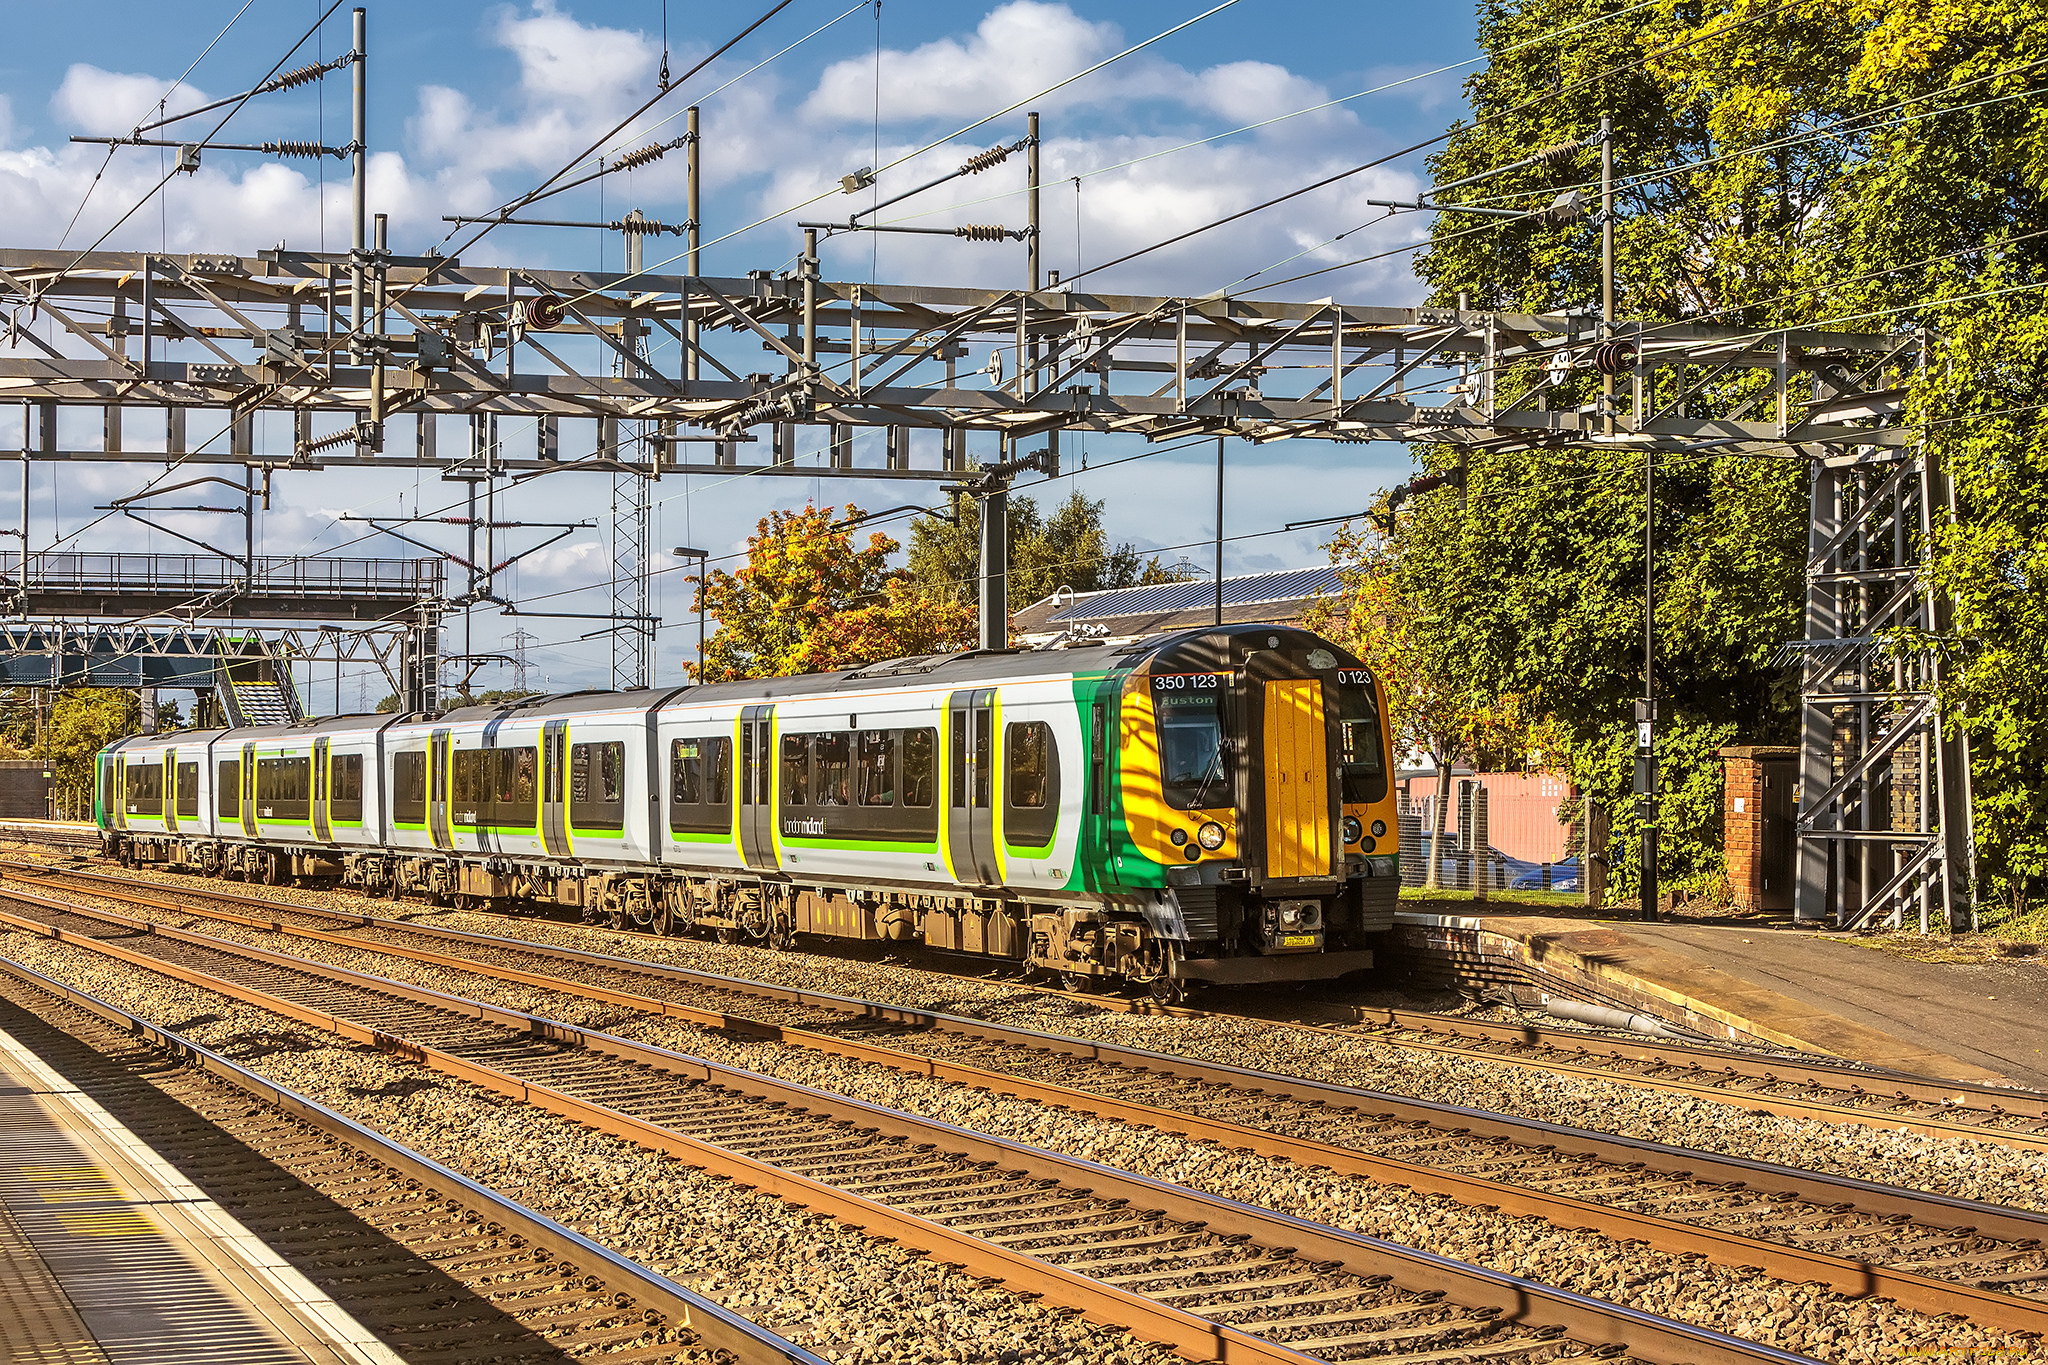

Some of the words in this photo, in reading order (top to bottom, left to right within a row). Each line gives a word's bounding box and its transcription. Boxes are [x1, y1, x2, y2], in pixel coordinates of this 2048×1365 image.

[1155, 675, 1185, 690] 350
[1190, 674, 1217, 689] 123
[1349, 670, 1371, 684] 123
